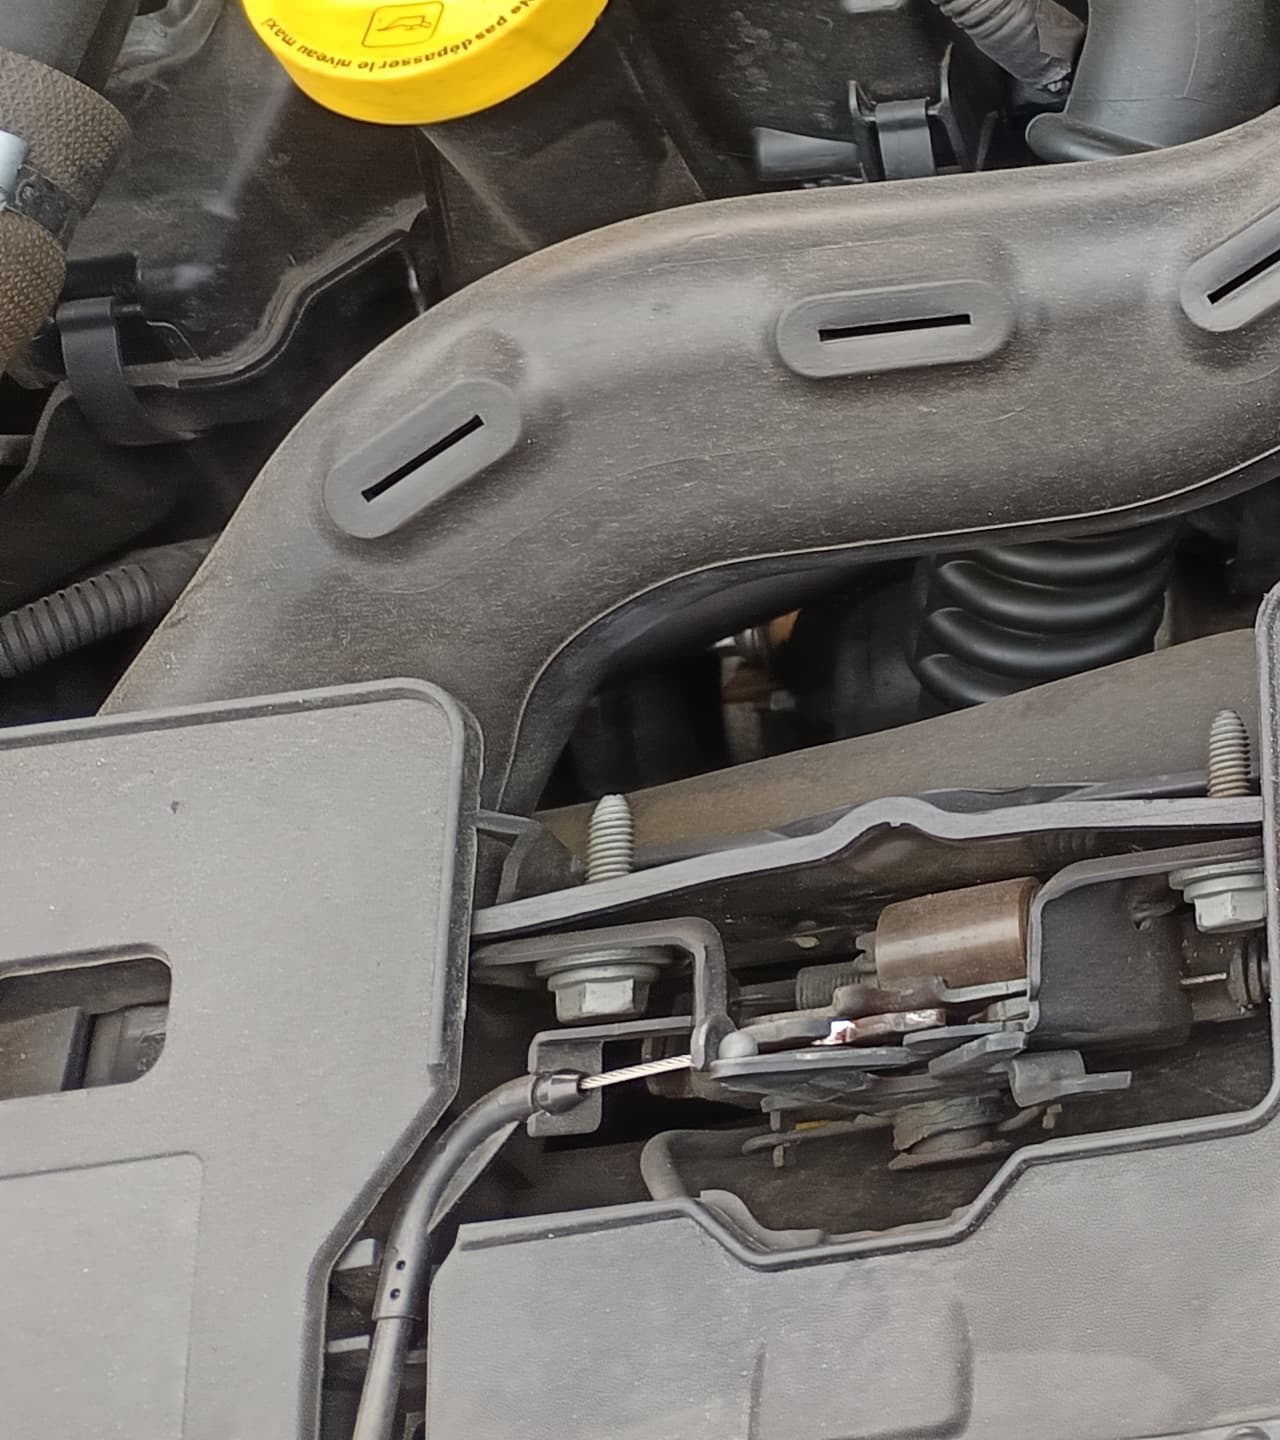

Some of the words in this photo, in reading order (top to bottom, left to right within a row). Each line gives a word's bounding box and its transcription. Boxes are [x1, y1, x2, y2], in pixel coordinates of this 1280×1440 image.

[261, 16, 297, 48] maxi
[474, 15, 509, 41] pas
[298, 44, 352, 70] niveau
[357, 61, 377, 72] le
[378, 38, 474, 71] dépasser
